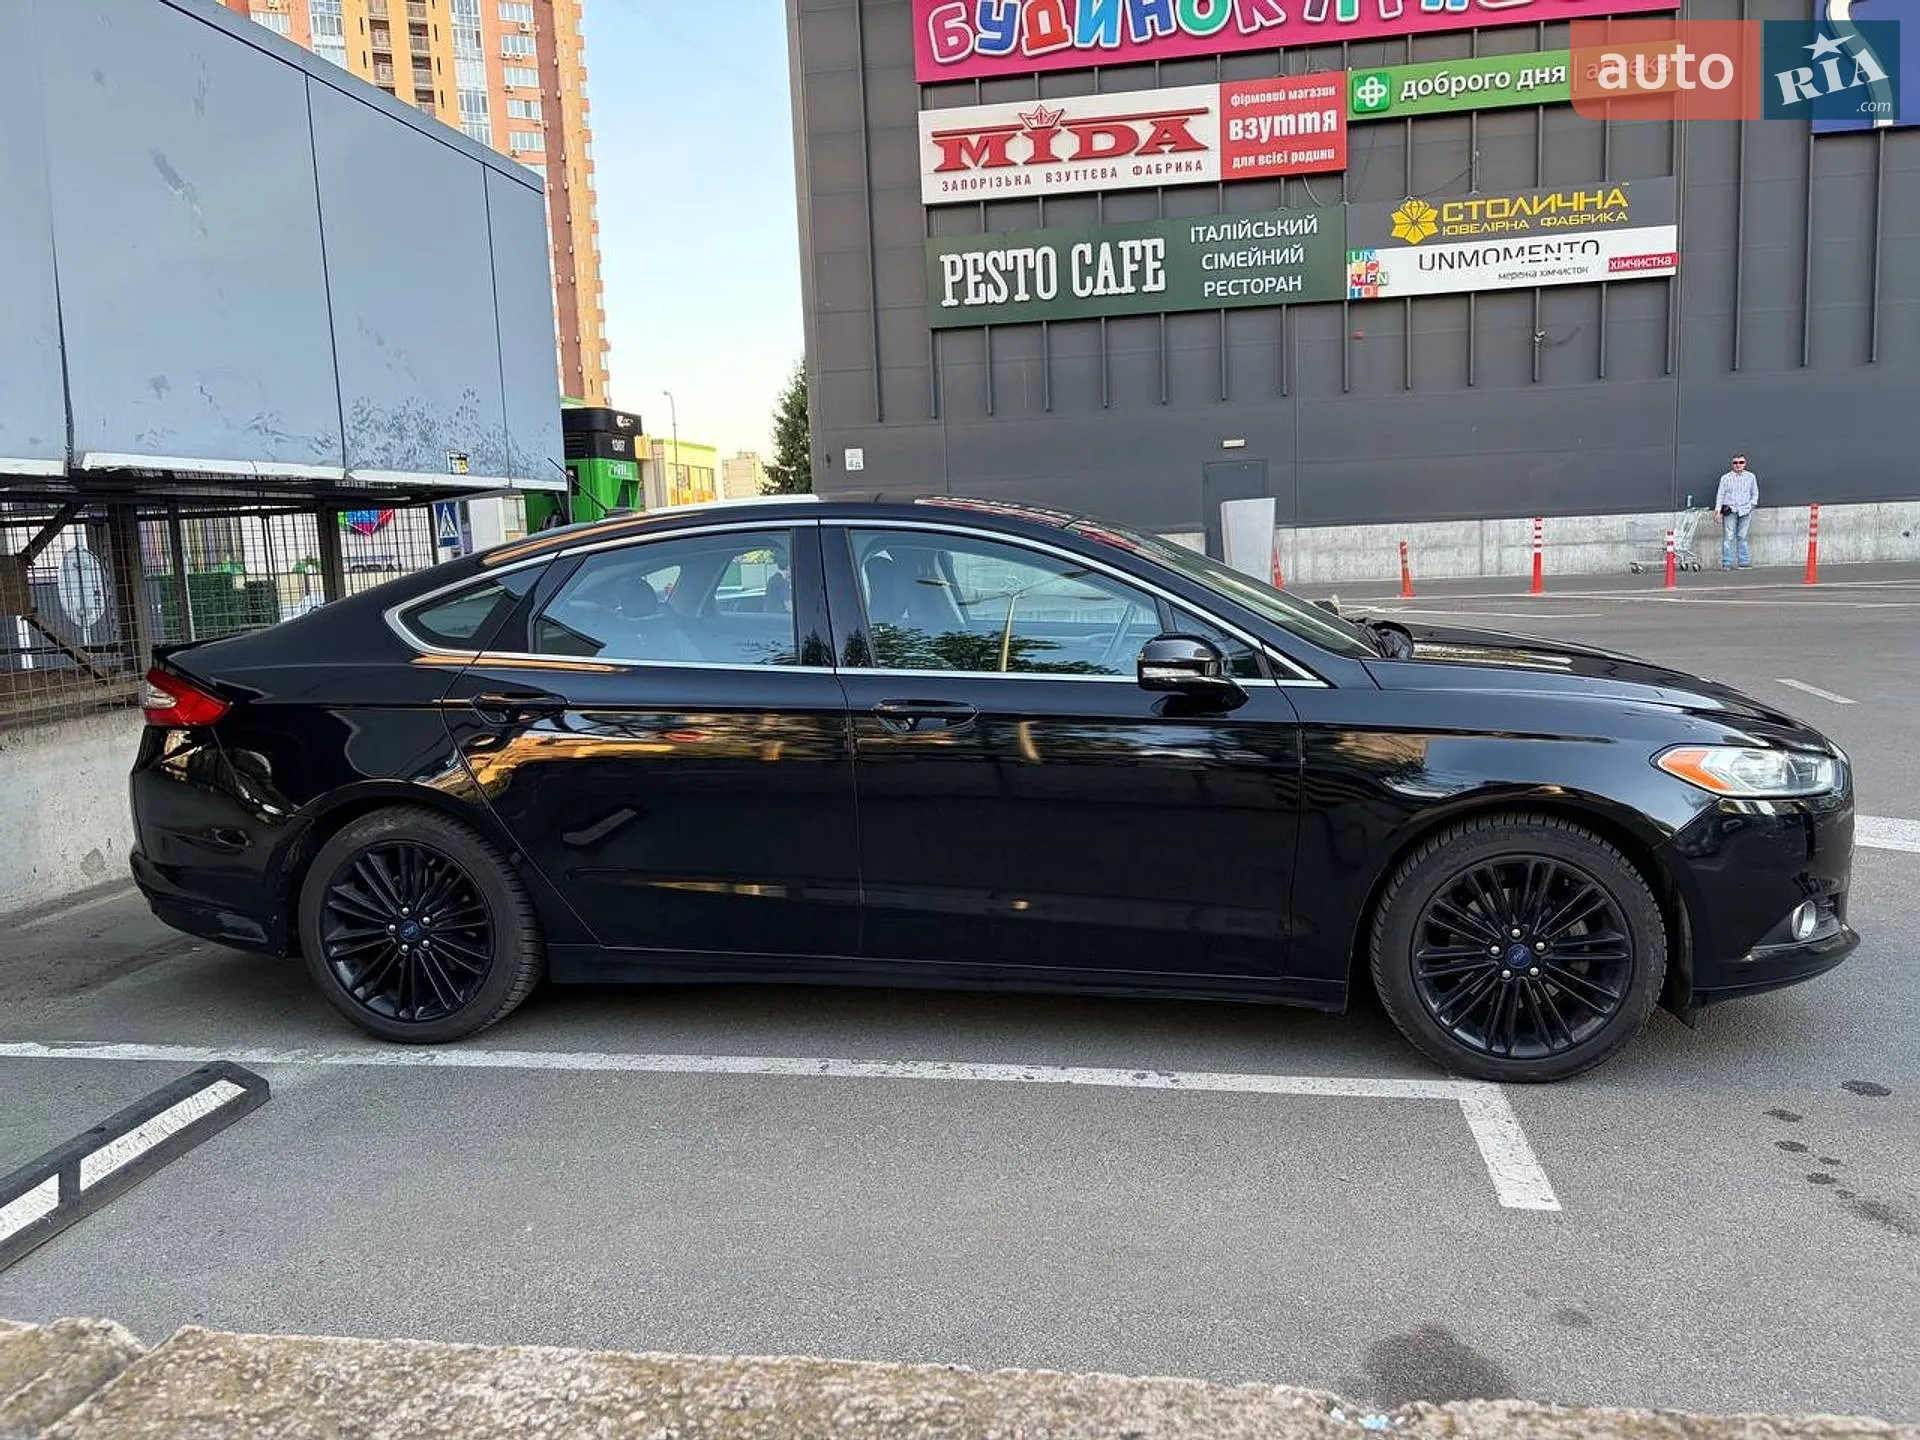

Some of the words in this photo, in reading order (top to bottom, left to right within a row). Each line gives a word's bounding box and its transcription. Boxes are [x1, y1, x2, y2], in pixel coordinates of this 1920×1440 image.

[1288, 85, 1336, 100] магазин
[1400, 70, 1511, 101] доброго
[1517, 65, 1567, 91] дня
[1585, 57, 1671, 80] аека
[1229, 109, 1337, 144] взуття
[1232, 155, 1256, 169] для
[1258, 150, 1289, 166] всієї
[1291, 147, 1335, 165] родини
[942, 174, 1032, 192] ЗАПОРІЗЬКА
[1045, 167, 1118, 184] ВЗУТТЄВА
[1132, 159, 1204, 176] ФАБРИКА
[1442, 188, 1629, 223] СТОЛИЧНА
[1189, 213, 1320, 244] ІТАЛІЙСЬКИЙ
[1442, 219, 1530, 236] ЮВЕЛІРНА
[1540, 210, 1629, 227] ФАБРИКА
[1201, 243, 1305, 271] СІМЕЙНИЙ
[1418, 239, 1600, 272] UNMOMENTO
[1609, 254, 1672, 271] хімчистка
[939, 246, 1059, 308] PESTO
[1071, 238, 1167, 298] CAFE
[1203, 274, 1303, 298] РЕСТОРАН
